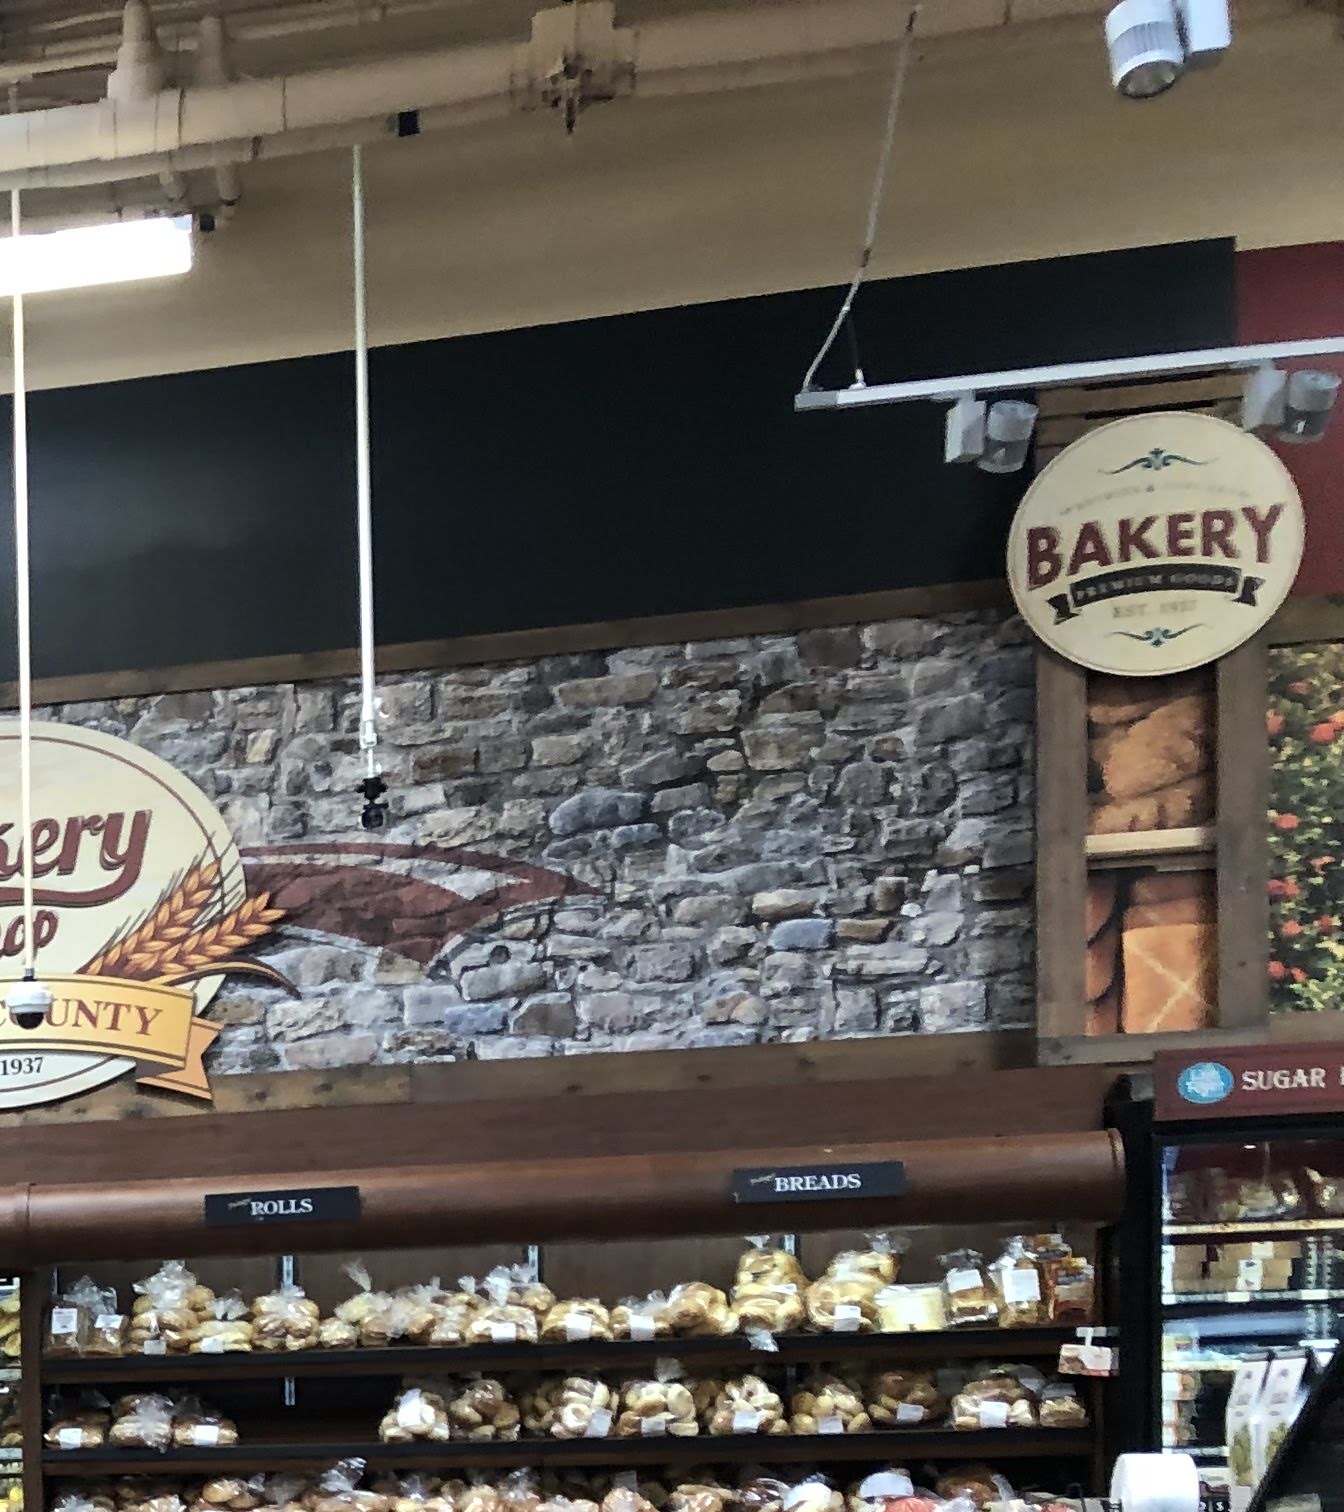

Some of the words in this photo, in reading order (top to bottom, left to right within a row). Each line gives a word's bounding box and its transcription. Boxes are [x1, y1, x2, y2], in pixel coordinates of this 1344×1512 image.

[1027, 504, 1287, 592] BAKERY
[0, 1056, 45, 1077] 1937
[1241, 1067, 1327, 1091] SUGAR
[774, 1172, 862, 1193] BREADS
[250, 1197, 314, 1217] ROLLS
